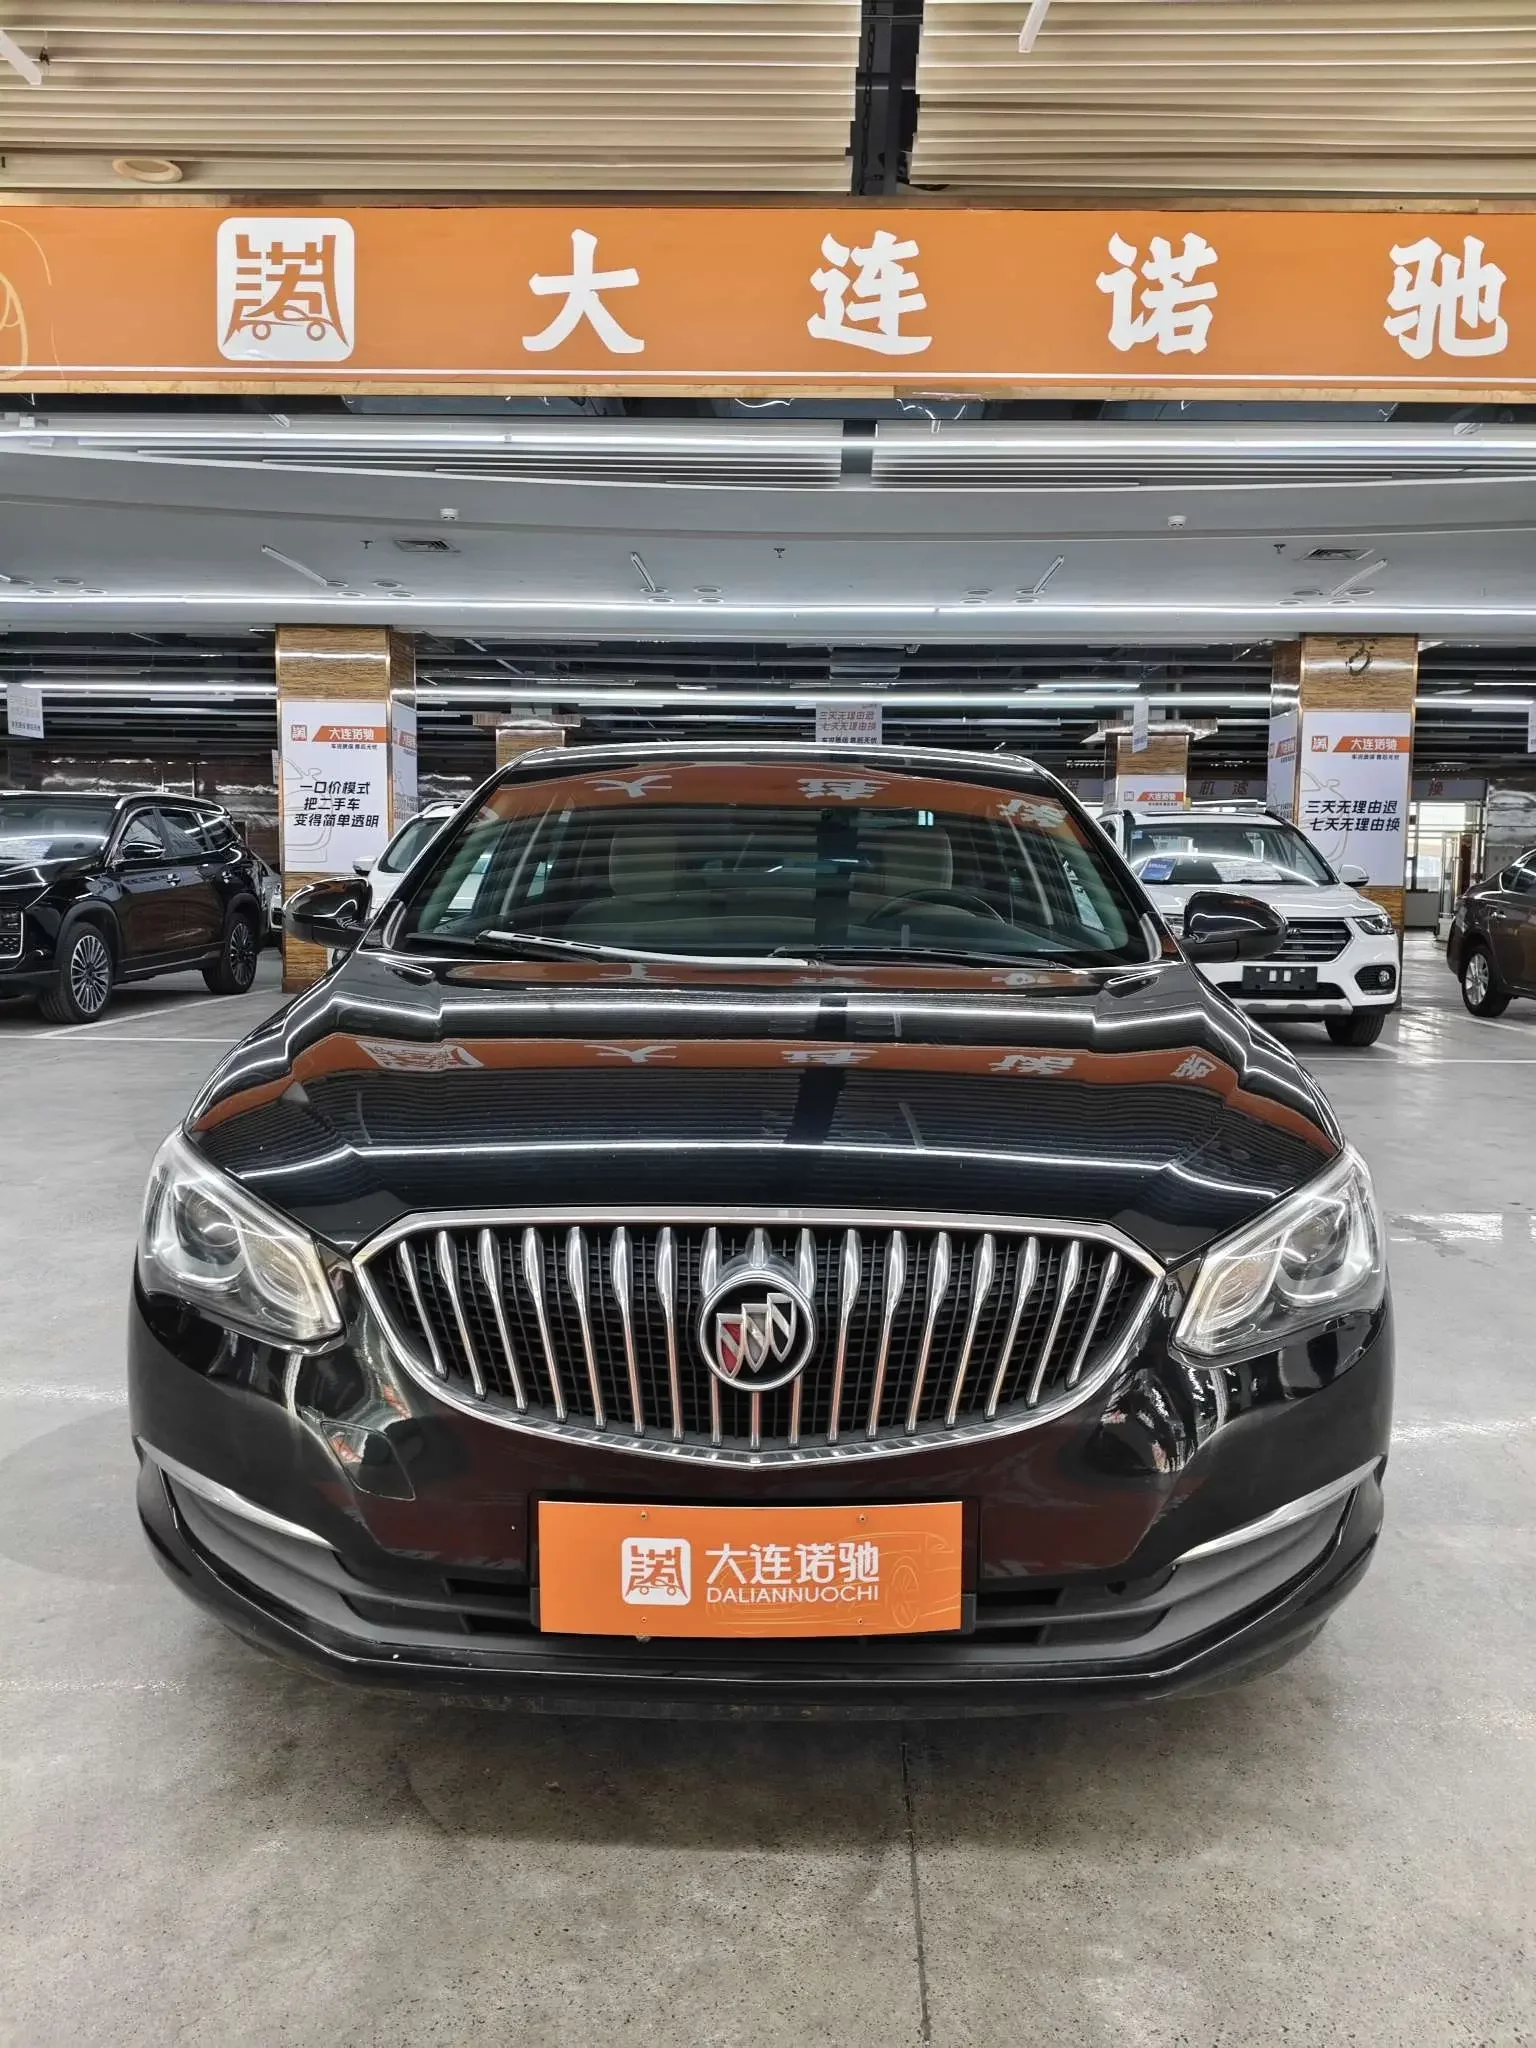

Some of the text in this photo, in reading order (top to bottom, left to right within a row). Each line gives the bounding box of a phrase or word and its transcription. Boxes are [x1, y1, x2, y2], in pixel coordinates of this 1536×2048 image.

[522, 228, 1509, 360] 大连诺驰
[328, 727, 375, 741] 大连诺驰
[1351, 738, 1397, 751] 大连诺驰
[300, 781, 370, 796] 一口价模式
[304, 797, 360, 811] 把二手车
[1305, 800, 1398, 814] 三天无理由退
[294, 814, 379, 828] 变得简单透明
[1310, 817, 1400, 832] 七天无理由换
[705, 1541, 880, 1585] 大连诺驰
[706, 1585, 879, 1604] DALIANNUOCHI
